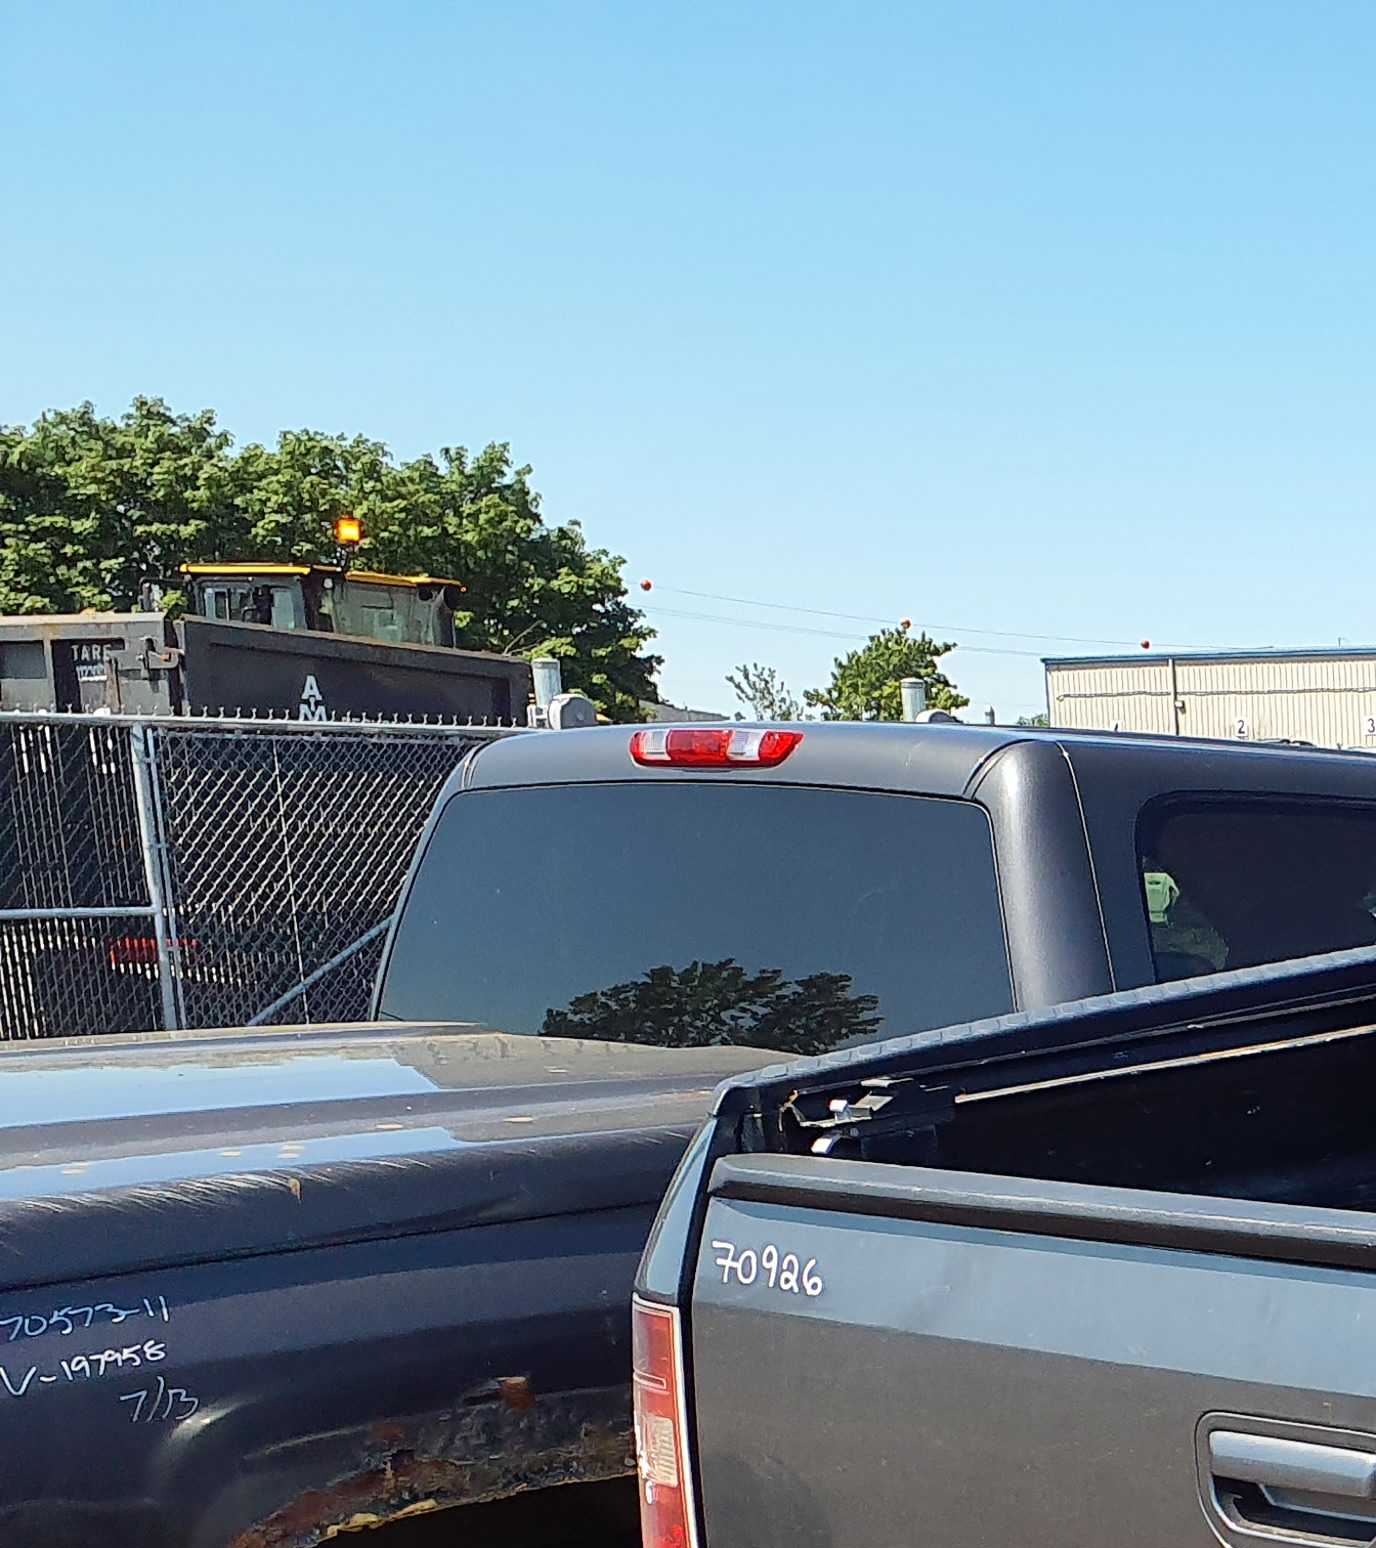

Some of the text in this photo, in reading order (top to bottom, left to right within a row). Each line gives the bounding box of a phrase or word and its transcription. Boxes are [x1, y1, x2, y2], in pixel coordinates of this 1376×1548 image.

[1237, 719, 1246, 734] 2
[1367, 718, 1376, 733] 3
[711, 1240, 823, 1296] 70926
[0, 1339, 168, 1396] V-197958
